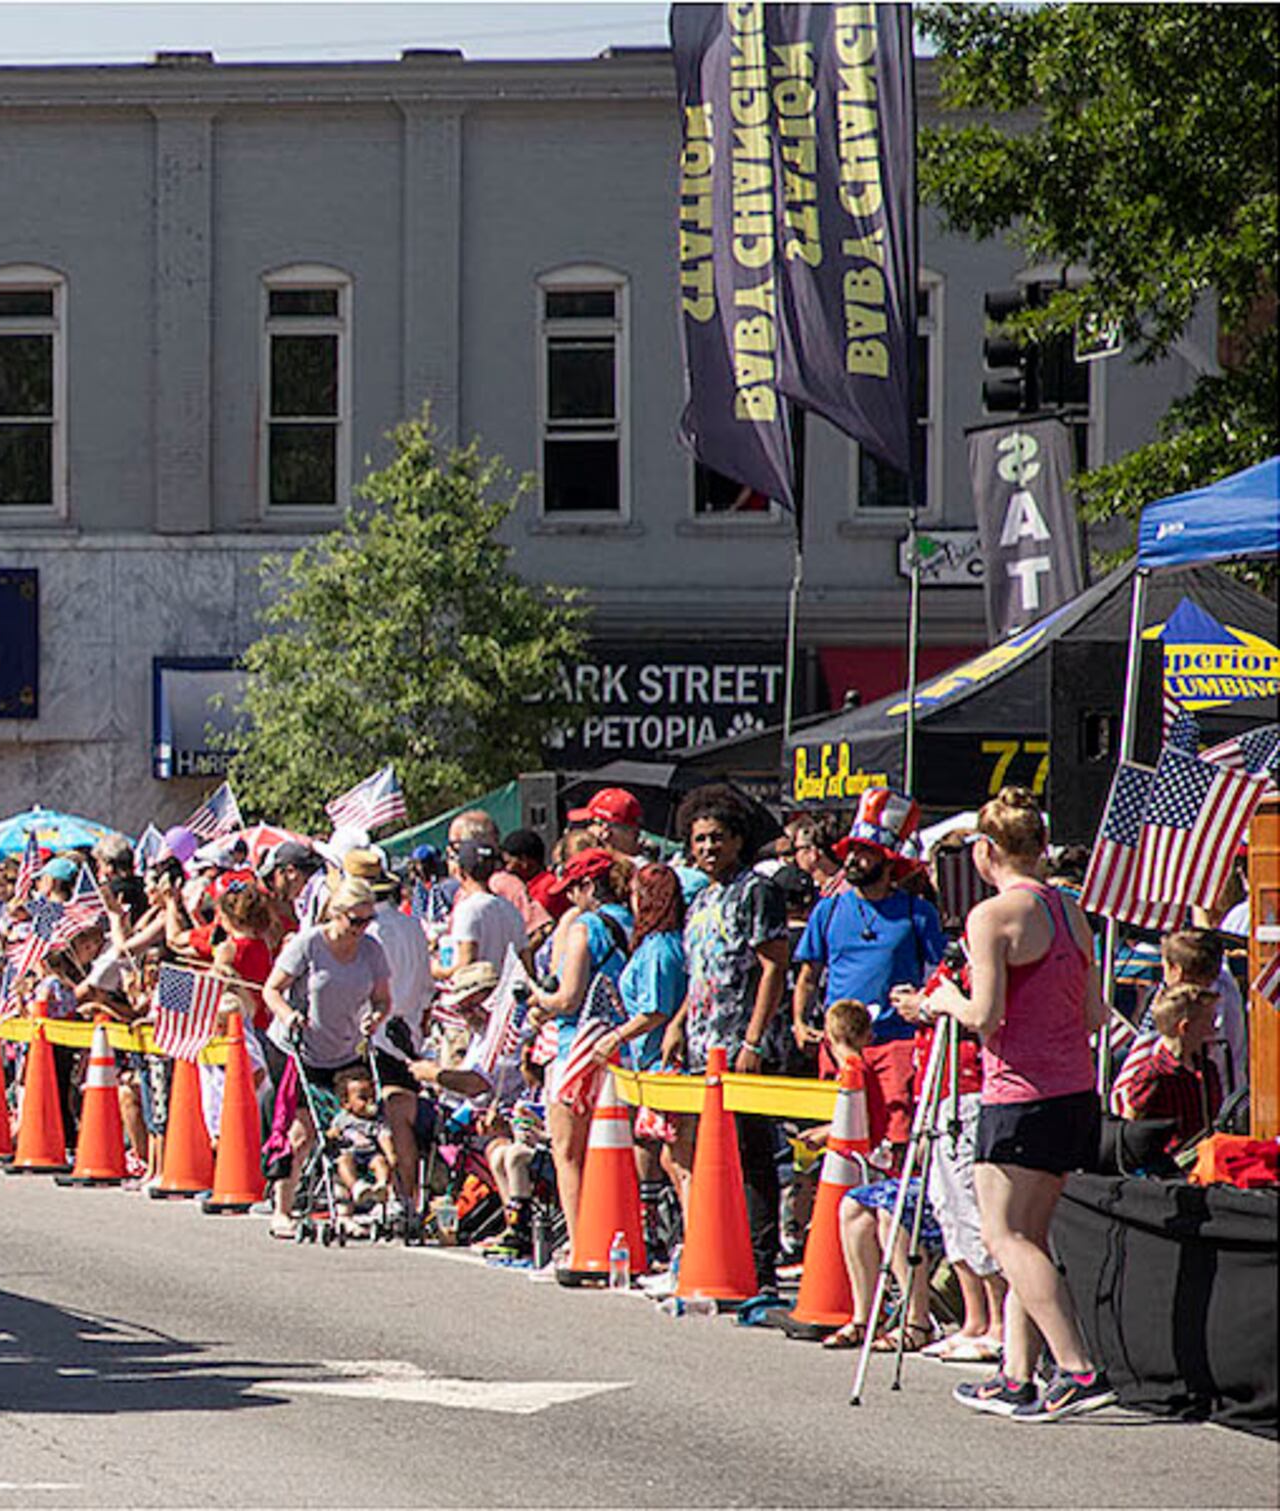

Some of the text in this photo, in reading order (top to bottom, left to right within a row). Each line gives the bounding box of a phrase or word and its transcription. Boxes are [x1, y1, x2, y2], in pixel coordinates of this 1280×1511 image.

[521, 664, 782, 704] ARK STREET
[583, 715, 717, 749] PETOPIA
